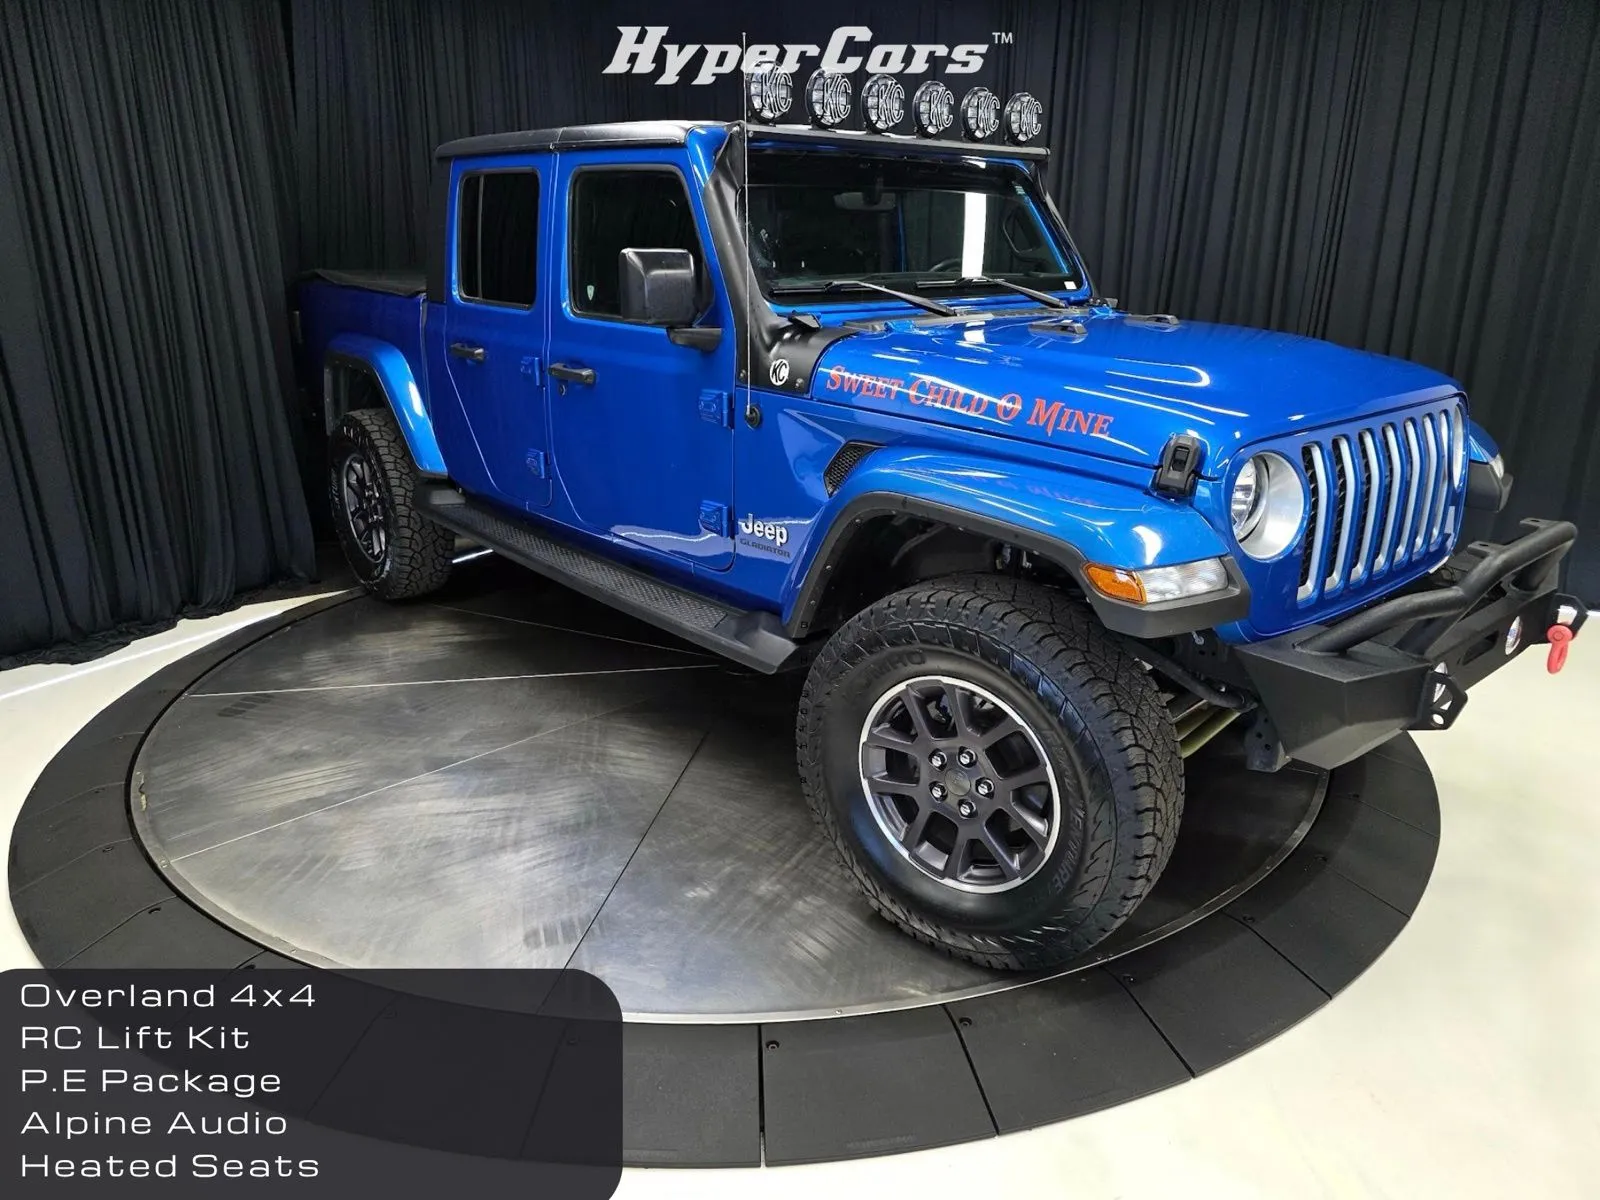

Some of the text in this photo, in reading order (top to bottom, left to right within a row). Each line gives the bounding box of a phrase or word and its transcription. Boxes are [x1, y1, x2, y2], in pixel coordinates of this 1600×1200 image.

[762, 65, 793, 115] KC
[823, 73, 851, 120] KC
[878, 81, 905, 125] KC
[930, 87, 955, 130] KC
[977, 93, 1001, 135] KC
[1021, 98, 1043, 140] KC
[771, 361, 788, 384] KC
[1027, 398, 1114, 437] MINE
[738, 513, 788, 547] Jeep
[739, 538, 791, 559] GLADIATOR
